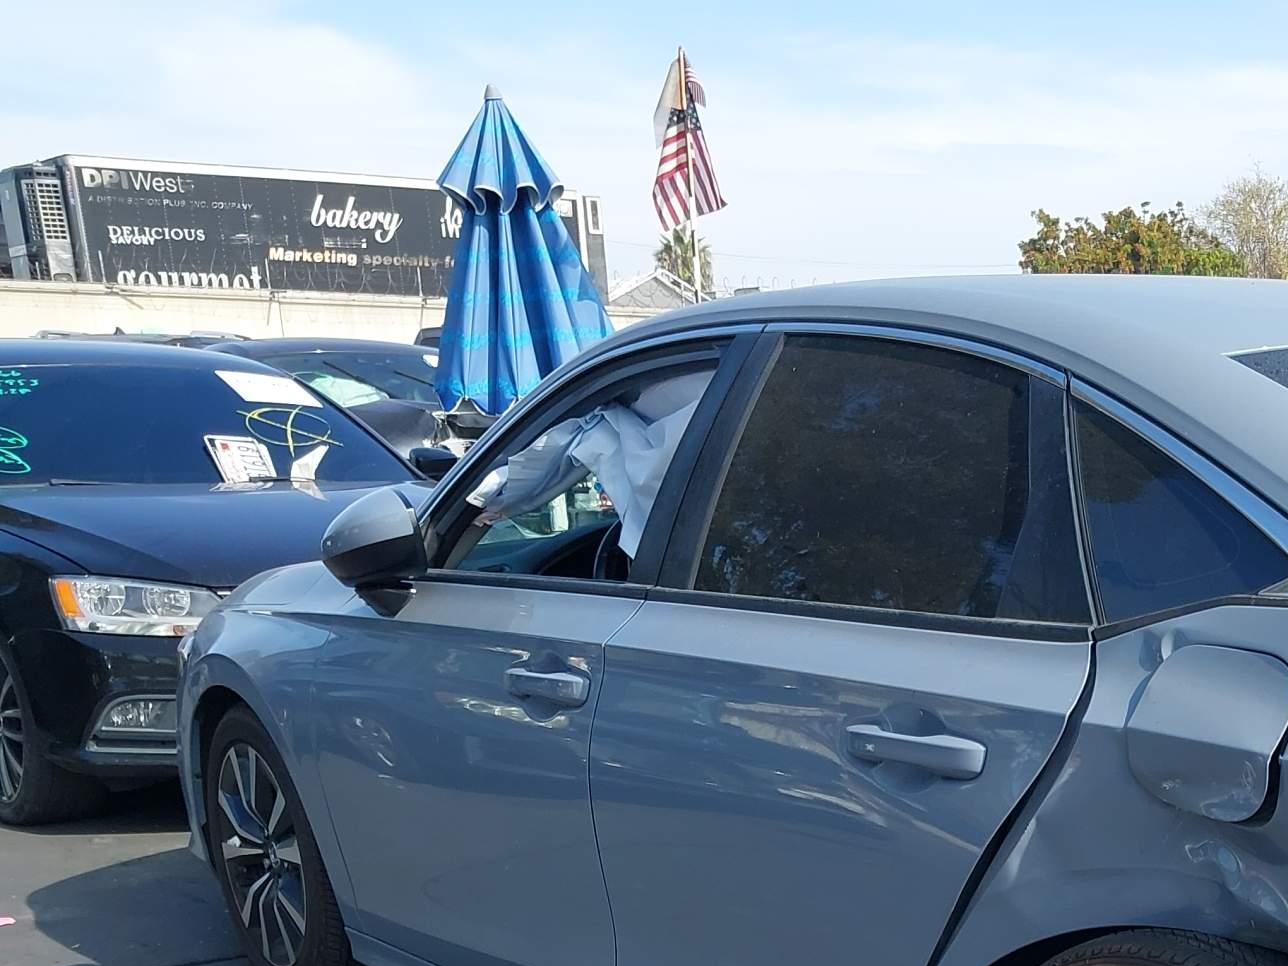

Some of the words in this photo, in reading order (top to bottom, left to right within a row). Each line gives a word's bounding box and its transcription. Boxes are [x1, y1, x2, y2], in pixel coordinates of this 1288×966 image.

[129, 171, 185, 193] West
[311, 194, 403, 243] bakery
[107, 225, 206, 242] DELICIOUS
[269, 247, 358, 266] Marketing
